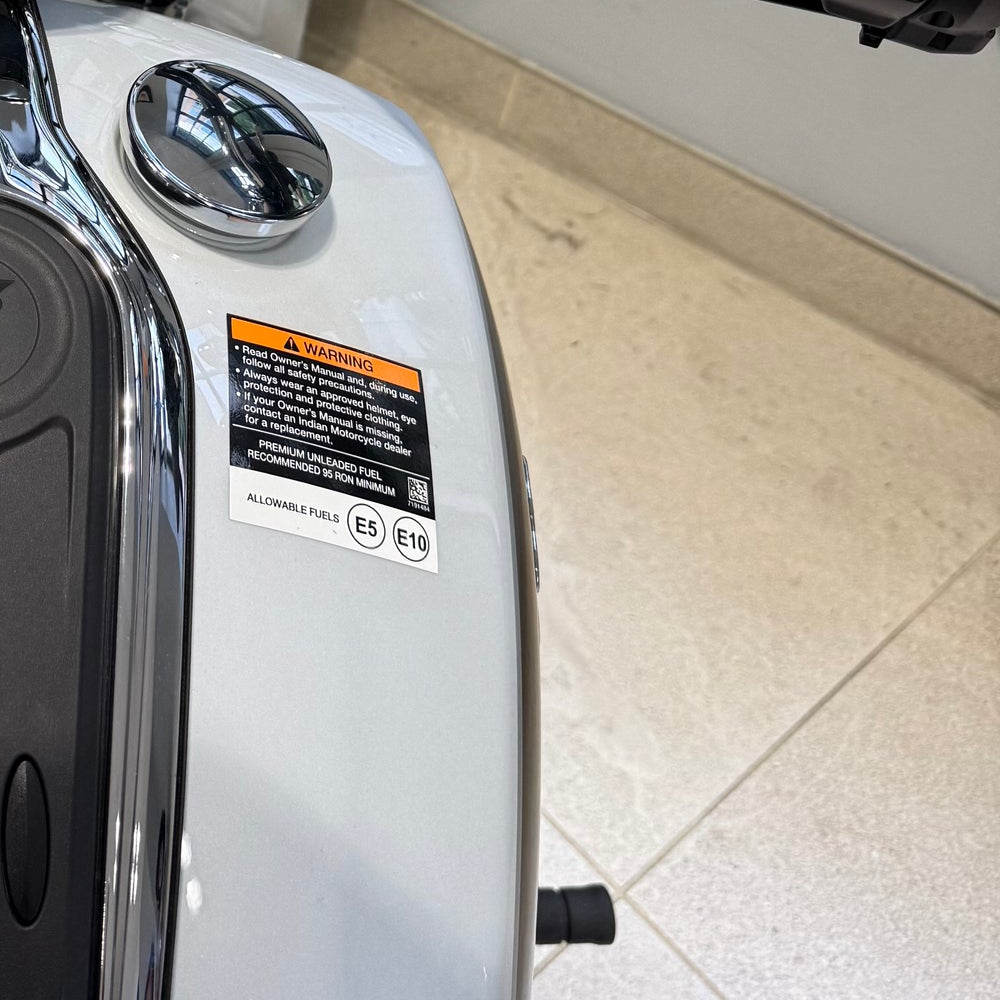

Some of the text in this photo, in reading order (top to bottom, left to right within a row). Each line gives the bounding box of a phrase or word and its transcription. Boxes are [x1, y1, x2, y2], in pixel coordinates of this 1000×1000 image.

[242, 345, 268, 359] Read
[270, 352, 309, 370] Owner's
[311, 363, 345, 380] Manual
[347, 374, 367, 388] and,
[369, 381, 398, 399] during
[242, 356, 375, 400] follow all safety precautions.
[303, 341, 374, 373] WARNING
[243, 368, 417, 425] Always wear an approved helmet, eye
[243, 380, 404, 432] protection and protective clothing.
[244, 391, 251, 401] If
[253, 395, 275, 407] your
[277, 400, 317, 418] Owner's
[319, 410, 354, 430] Manual
[355, 421, 364, 431] is
[244, 414, 334, 445] for a replacement.
[244, 404, 412, 457] contact an Indian Motorcycle dealer
[247, 448, 396, 497] RECOMMENDED 95 RON MINIMUM
[258, 439, 382, 481] PREMIUM UNLEADED FUEL
[246, 492, 340, 523] ALLOWABLE FUELS
[355, 515, 377, 538] E5
[397, 527, 427, 552] E10
